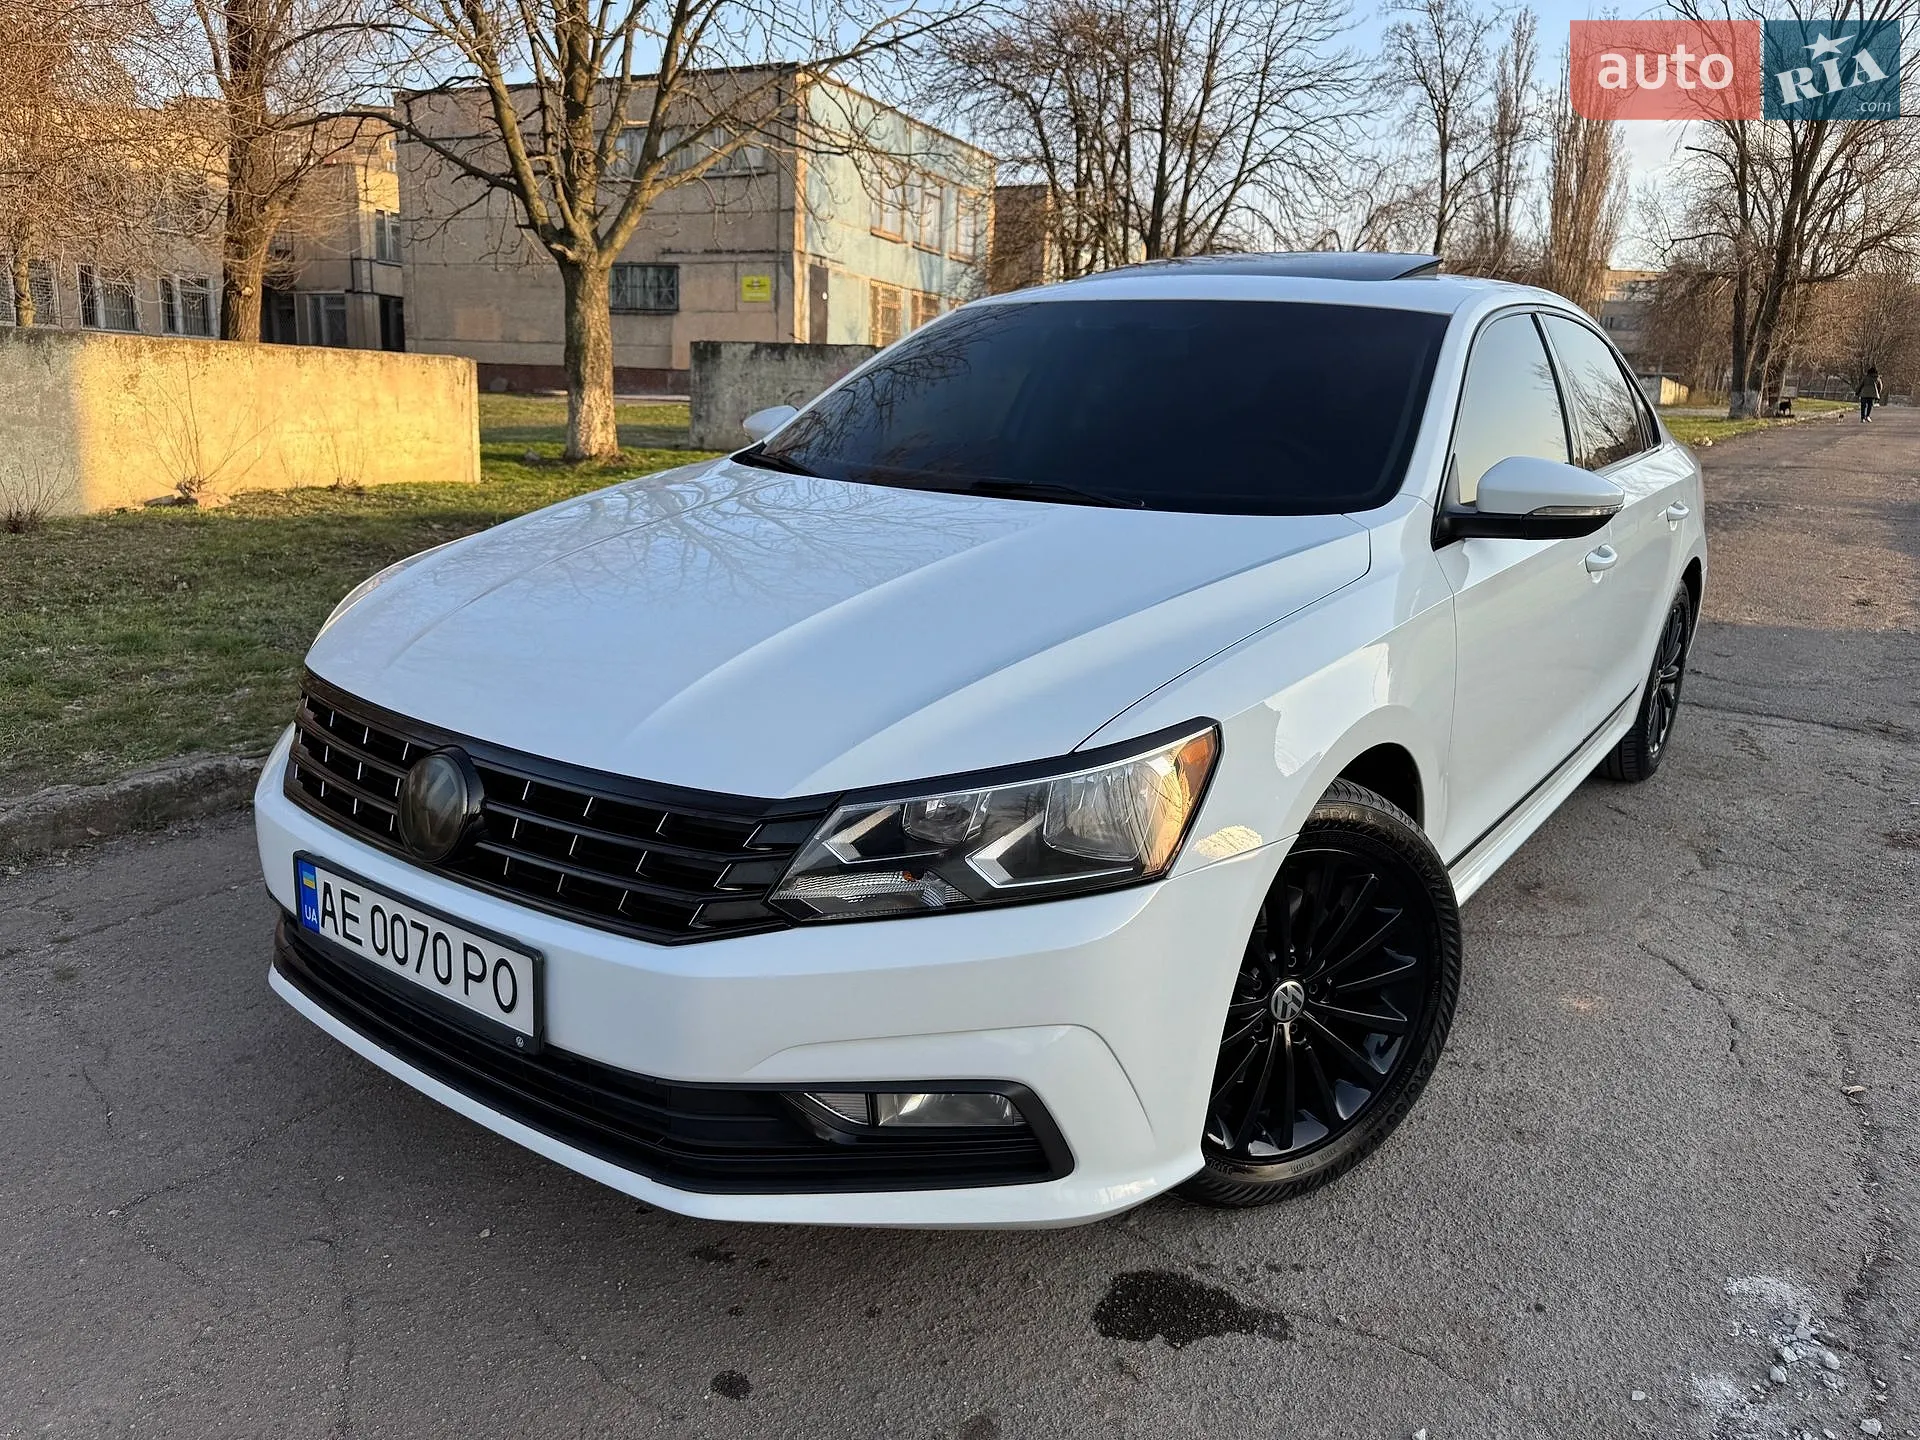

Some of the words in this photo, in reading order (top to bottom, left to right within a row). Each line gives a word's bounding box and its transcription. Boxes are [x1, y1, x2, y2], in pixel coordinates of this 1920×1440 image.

[304, 904, 318, 925] UA
[321, 881, 363, 947] AE
[370, 904, 452, 986] 0070
[463, 942, 518, 1014] PO
